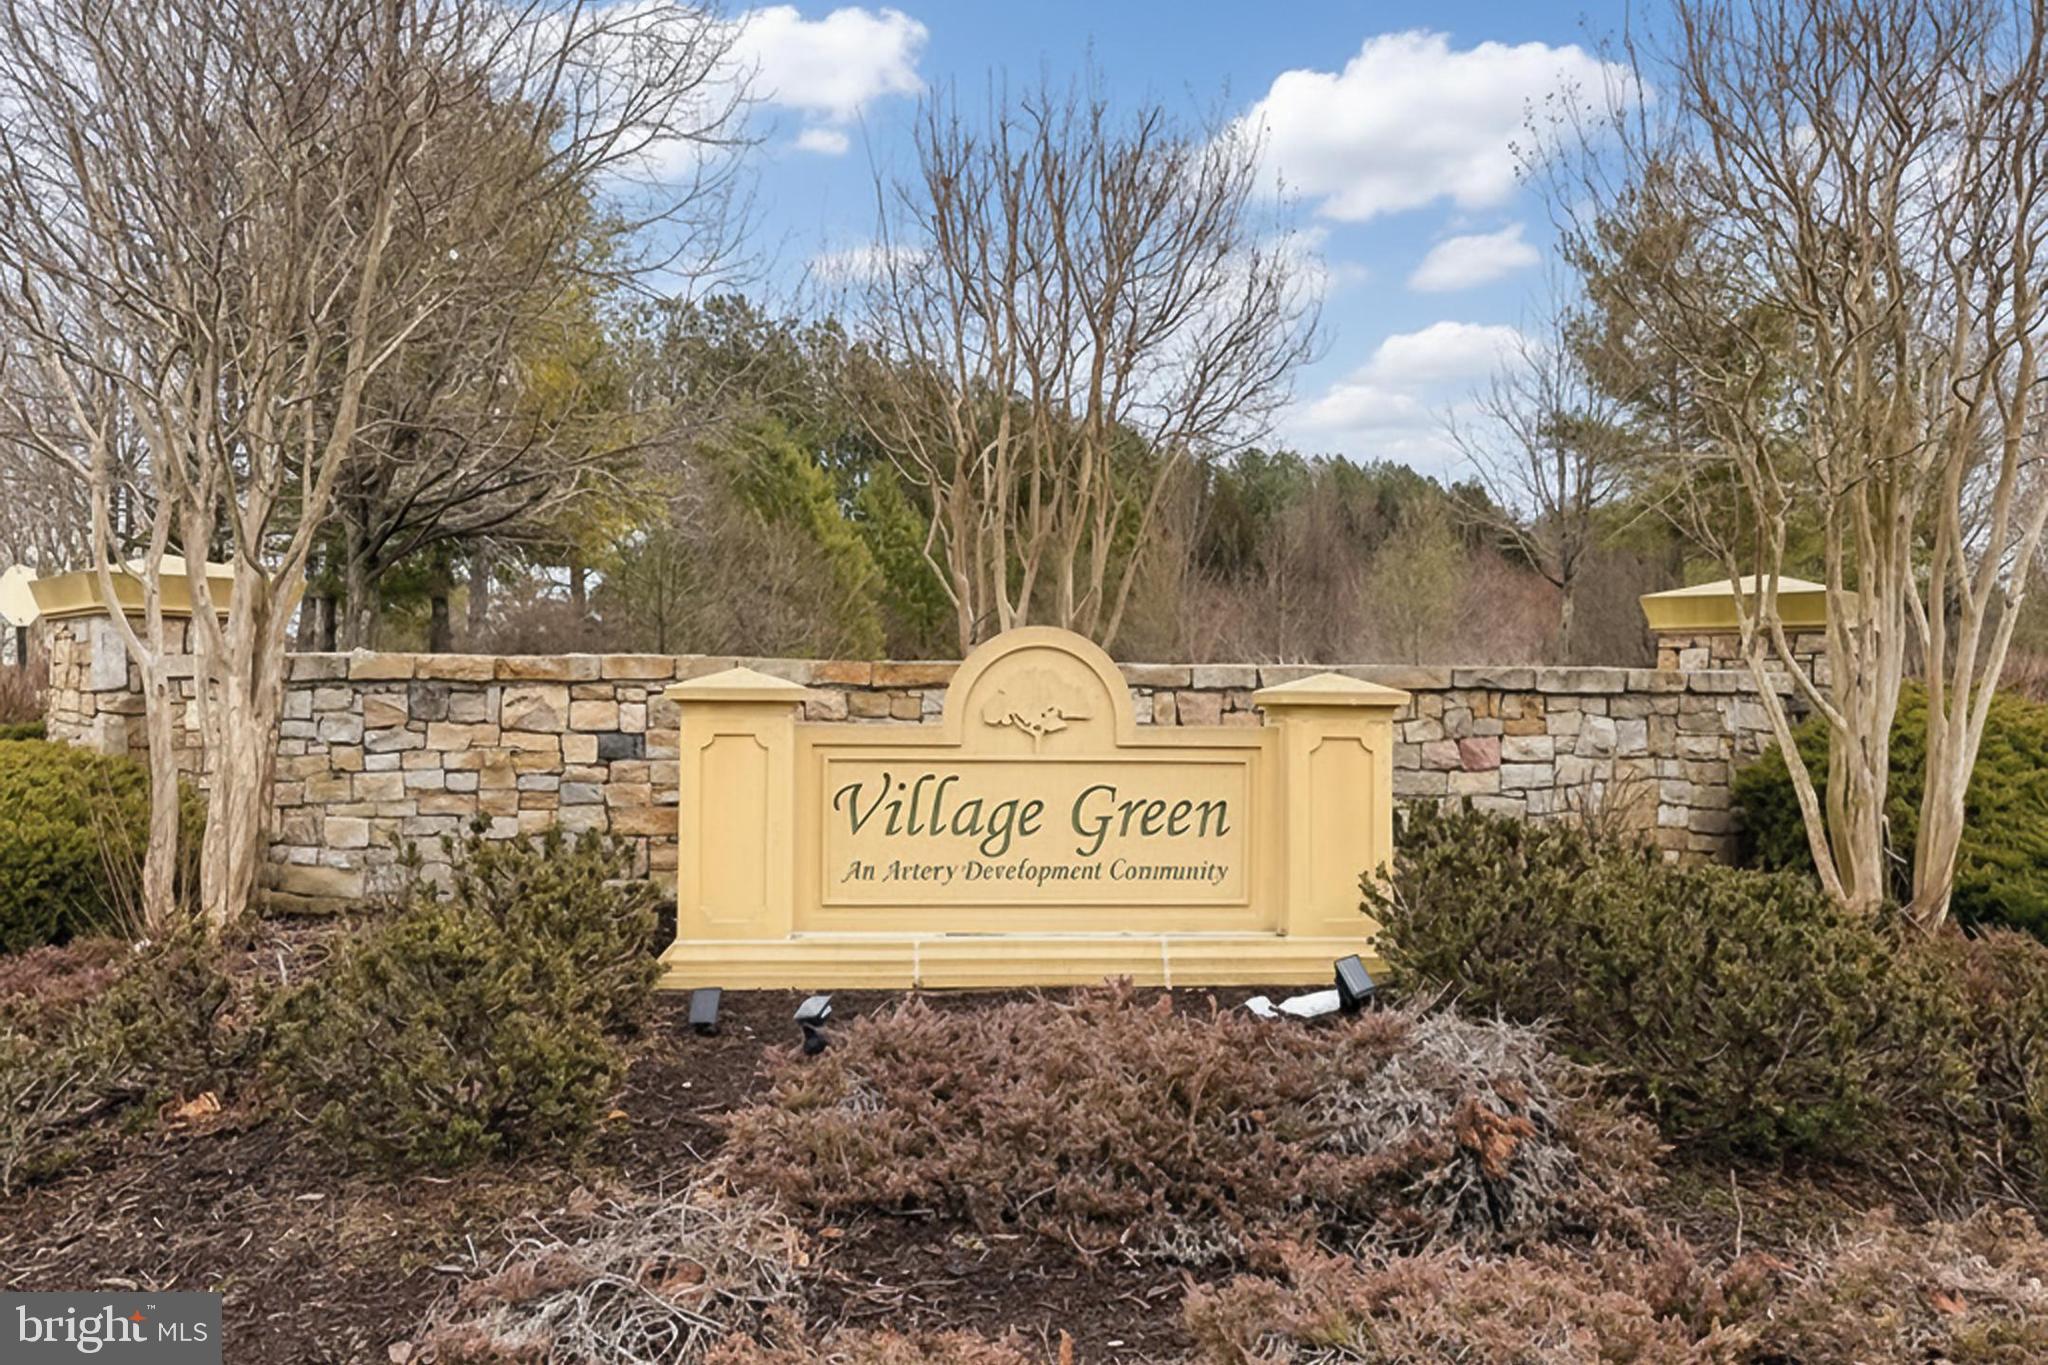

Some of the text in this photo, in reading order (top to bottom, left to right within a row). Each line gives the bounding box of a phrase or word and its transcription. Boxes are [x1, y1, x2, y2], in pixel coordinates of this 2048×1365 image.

[833, 772, 1231, 858] Village Green
[841, 858, 1229, 887] An Artery Development Community
